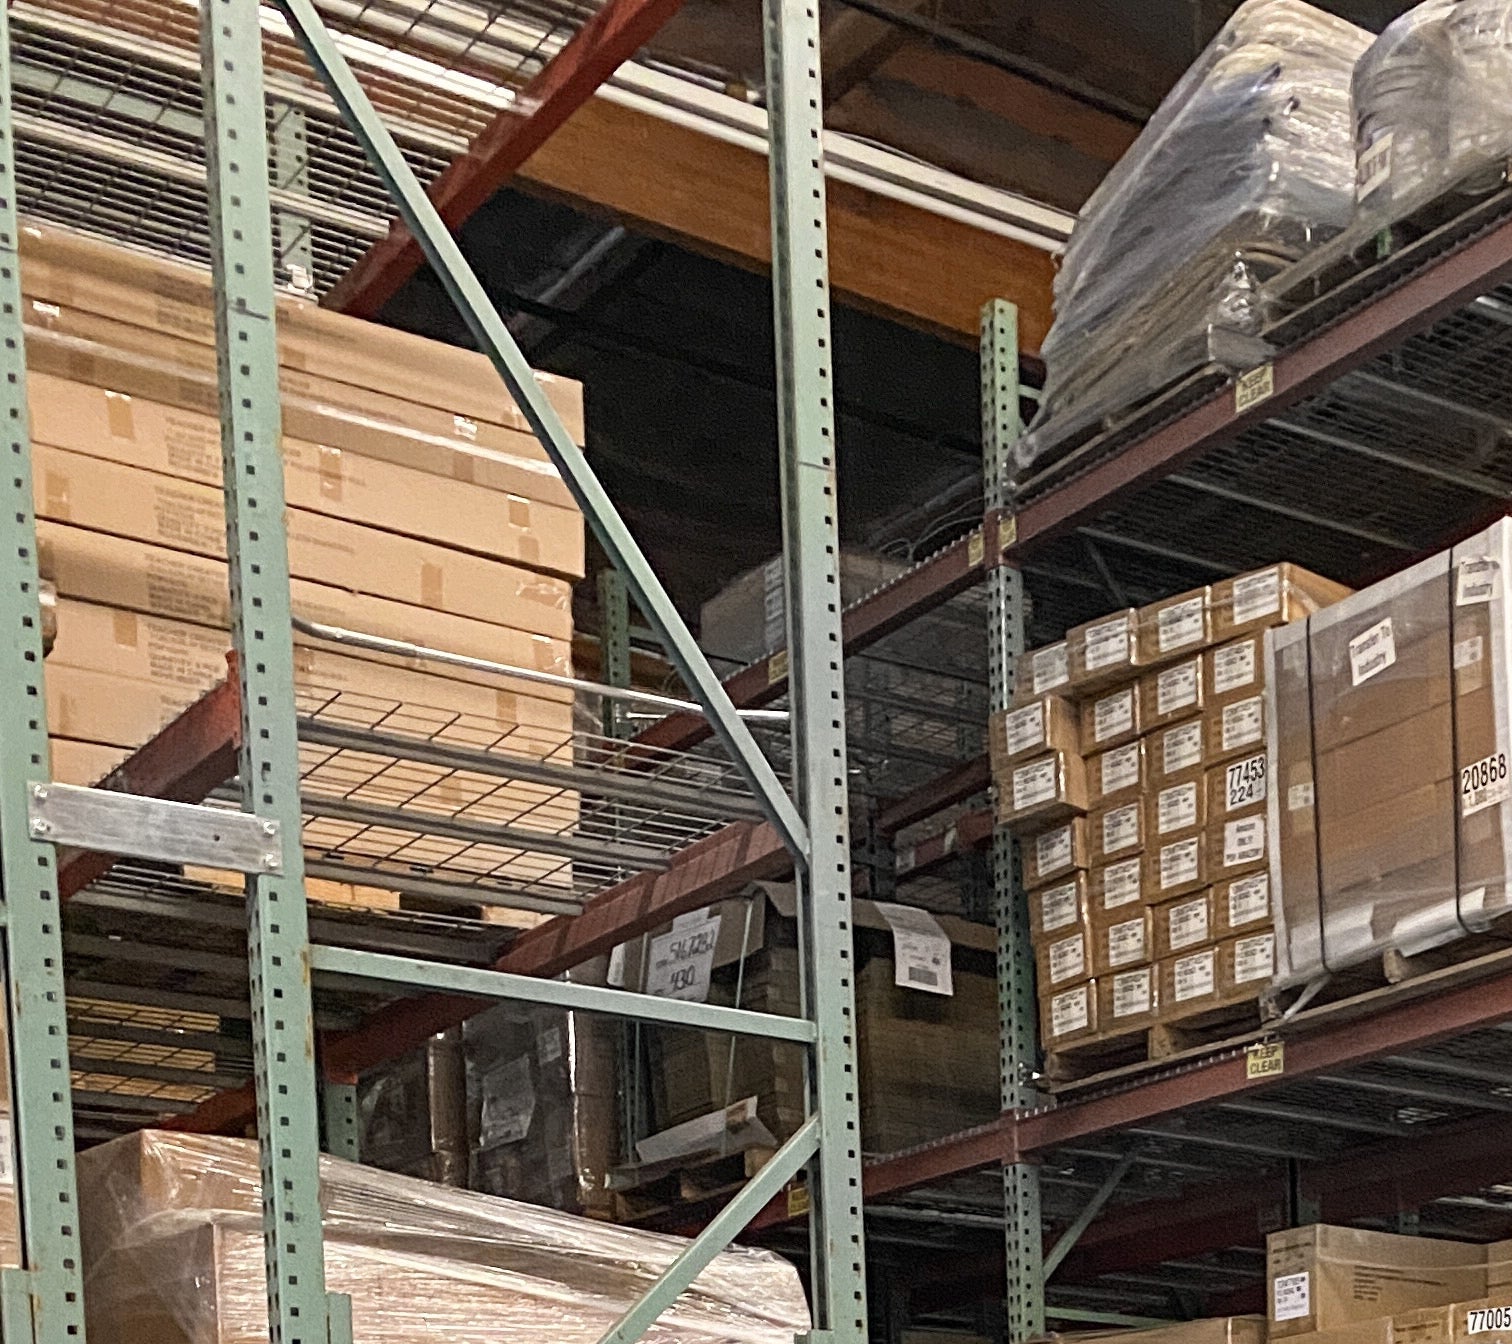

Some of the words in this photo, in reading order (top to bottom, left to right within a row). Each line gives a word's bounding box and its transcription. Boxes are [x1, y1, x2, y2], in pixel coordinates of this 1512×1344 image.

[1229, 757, 1265, 789] 77453
[1462, 753, 1507, 794] 20868
[1470, 1307, 1511, 1331] 77005
